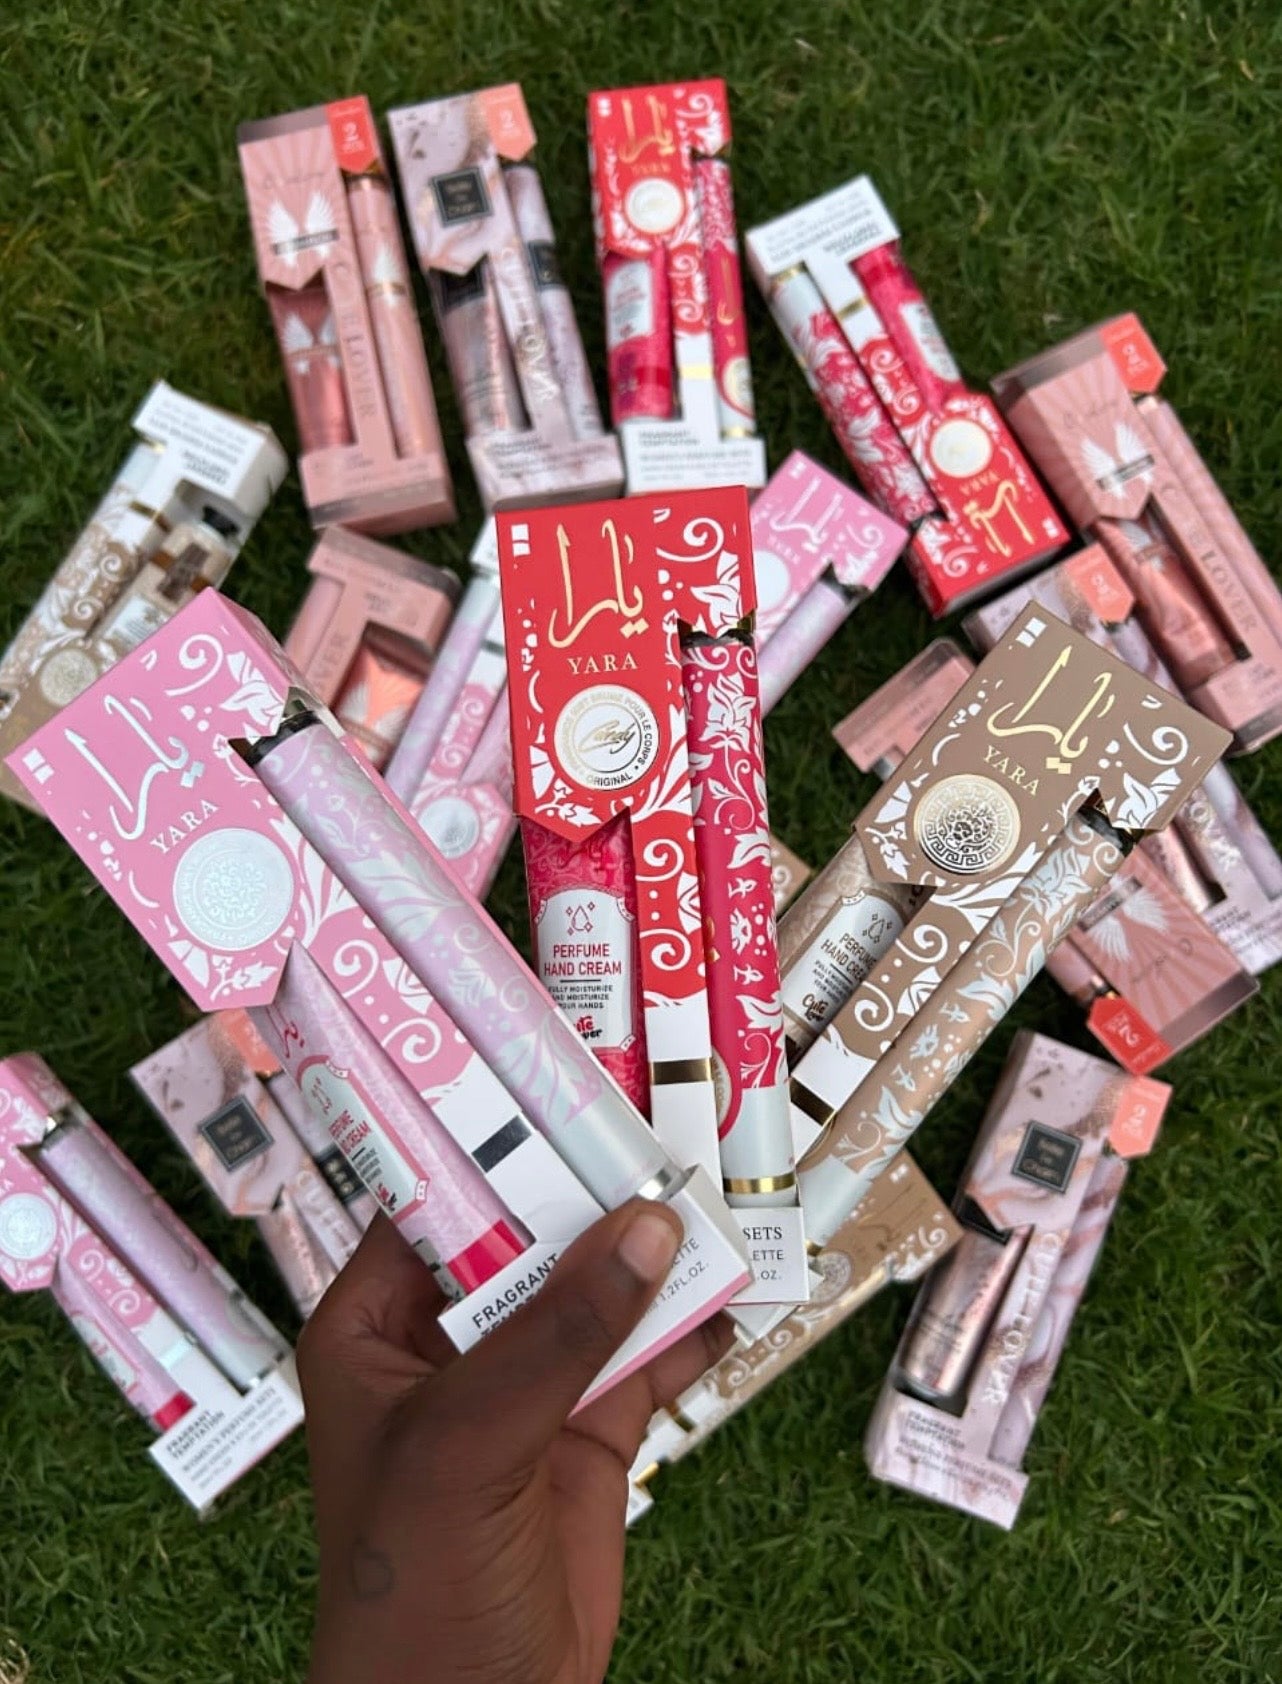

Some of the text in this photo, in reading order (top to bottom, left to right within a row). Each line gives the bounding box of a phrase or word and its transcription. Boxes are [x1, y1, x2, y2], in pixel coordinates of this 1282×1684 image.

[548, 519, 649, 648] يارا
[567, 652, 638, 675] YARA
[987, 645, 1115, 774] يارا
[641, 719, 651, 731] LE
[64, 695, 206, 840] يارا
[587, 772, 633, 787] ORIGINAL
[983, 745, 1039, 796] YARA
[150, 799, 219, 854] YARA
[553, 943, 610, 959] PERFUME
[820, 939, 849, 966] HAND
[839, 933, 878, 970] PERFUME
[544, 962, 622, 977] HAND CREAM
[566, 993, 610, 1001] MOISTURIZE
[569, 984, 614, 992] MOISTURIZE
[743, 1226, 783, 1240] SETS
[472, 1253, 558, 1329] FRAGRANT
